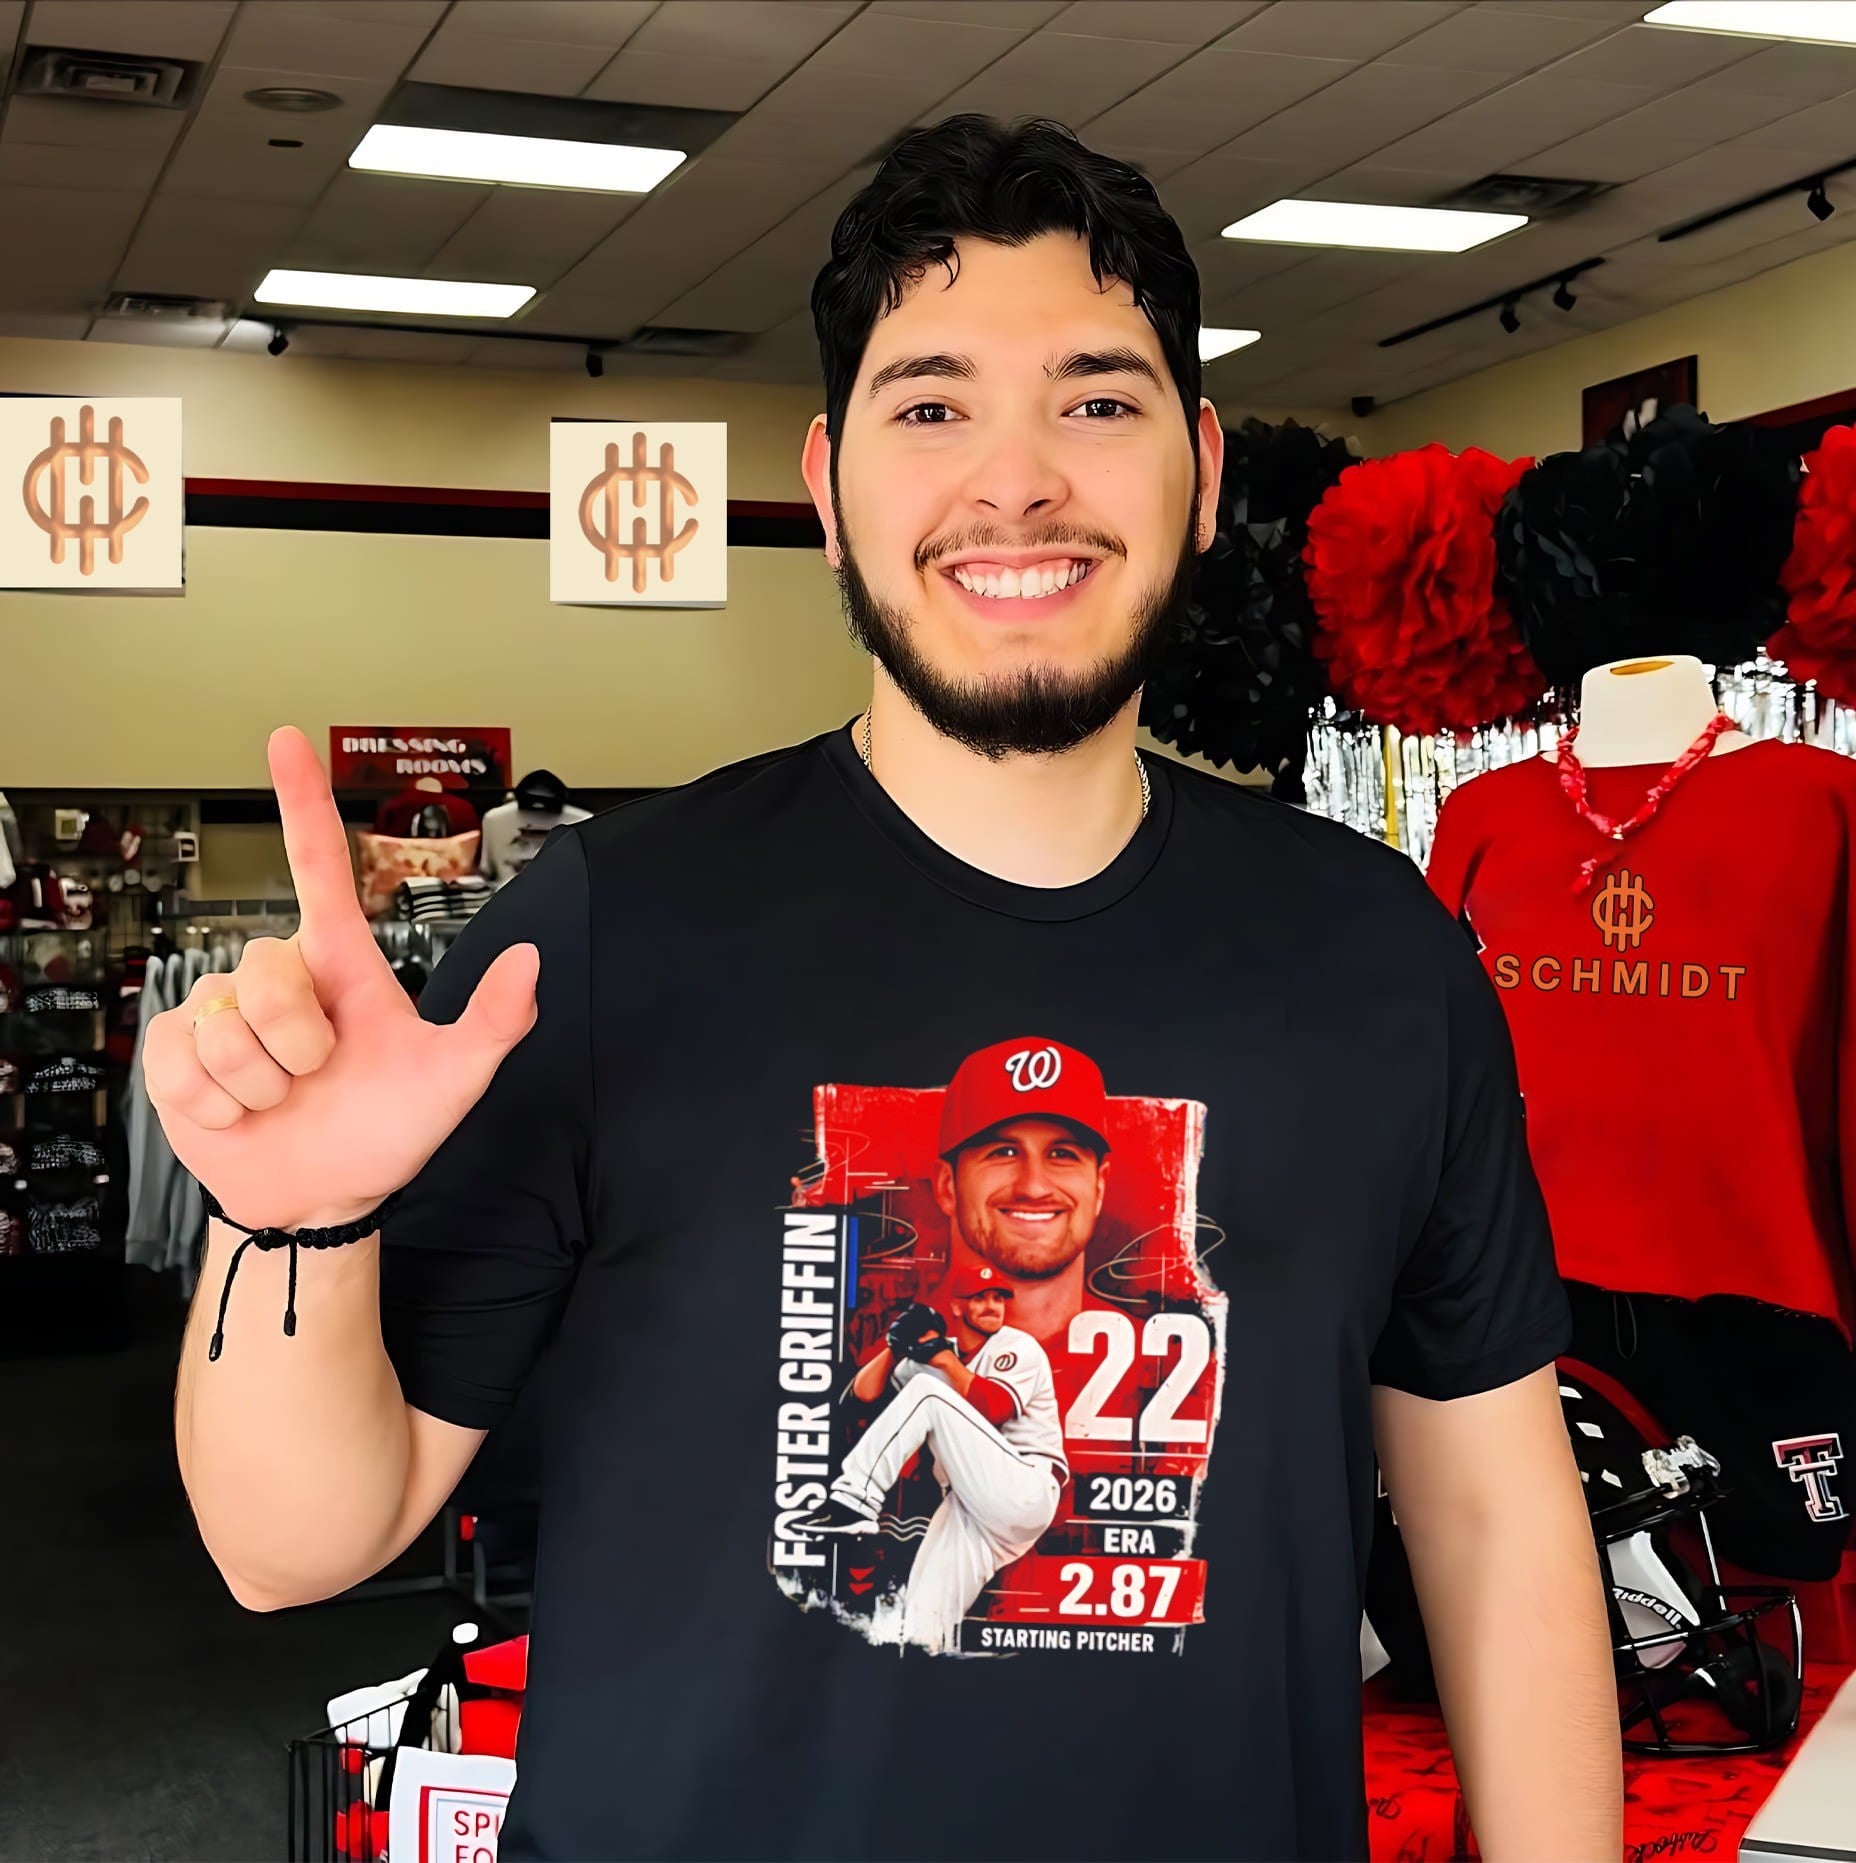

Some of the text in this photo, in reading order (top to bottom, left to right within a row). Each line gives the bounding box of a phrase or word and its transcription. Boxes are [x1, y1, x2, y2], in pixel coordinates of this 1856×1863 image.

[342, 736, 467, 754] DRESSING
[395, 758, 487, 775] ROOMS
[1493, 953, 1747, 1001] SCHMIDT
[773, 1212, 838, 1567] FOSTER GRIFFIN
[1064, 1309, 1211, 1444] 22
[1089, 1476, 1178, 1513] 2026
[1103, 1527, 1156, 1555] ERA
[1058, 1561, 1182, 1619] 2.87
[980, 1627, 1155, 1653] STARTING PITCHER
